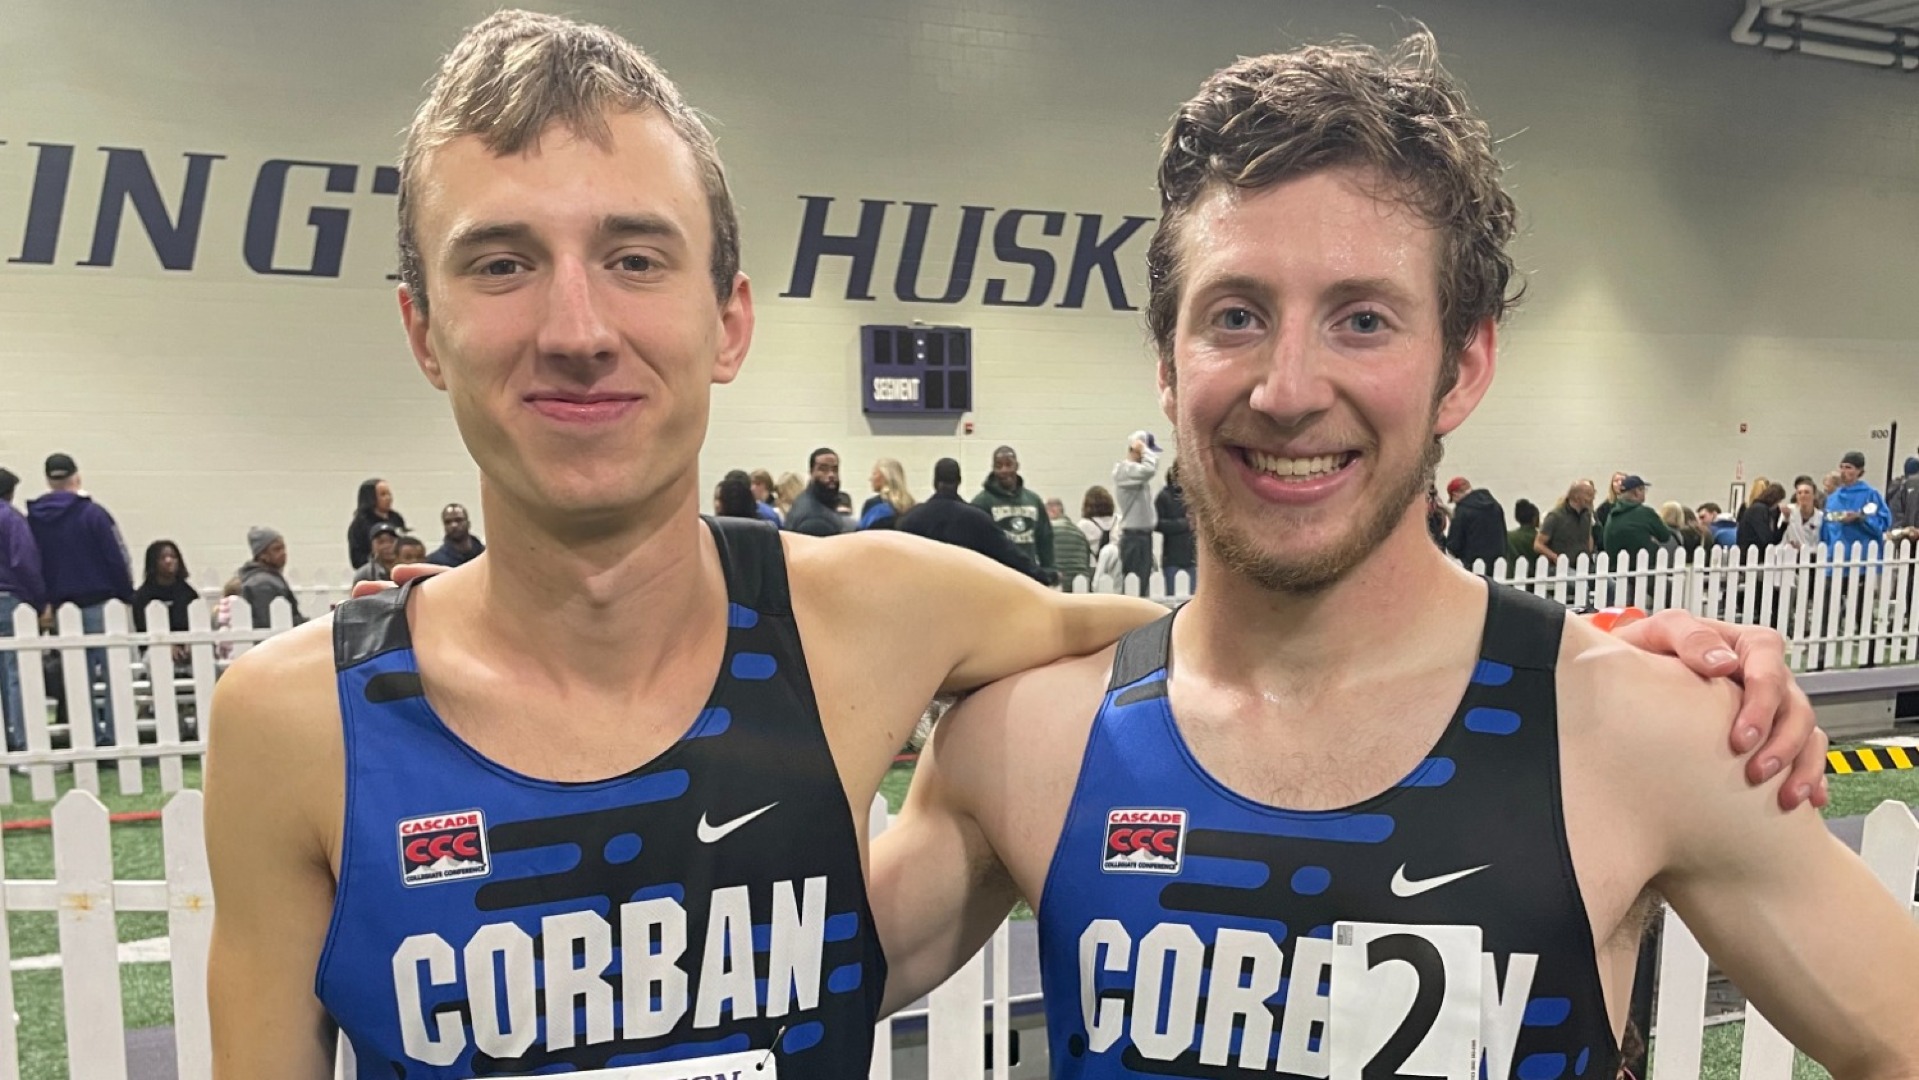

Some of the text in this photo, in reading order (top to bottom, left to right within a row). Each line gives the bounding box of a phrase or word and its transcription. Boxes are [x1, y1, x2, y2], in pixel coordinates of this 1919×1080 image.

[0, 141, 402, 281] ING
[873, 377, 920, 401] SEGMENT
[402, 814, 478, 834] CASCADE
[1110, 812, 1182, 823] CASCADE
[405, 832, 479, 862] CCC
[1108, 828, 1178, 853] CCC
[392, 875, 828, 1066] CORBAN
[1079, 918, 1539, 1080] CORBN
[1361, 933, 1448, 1080] 2
